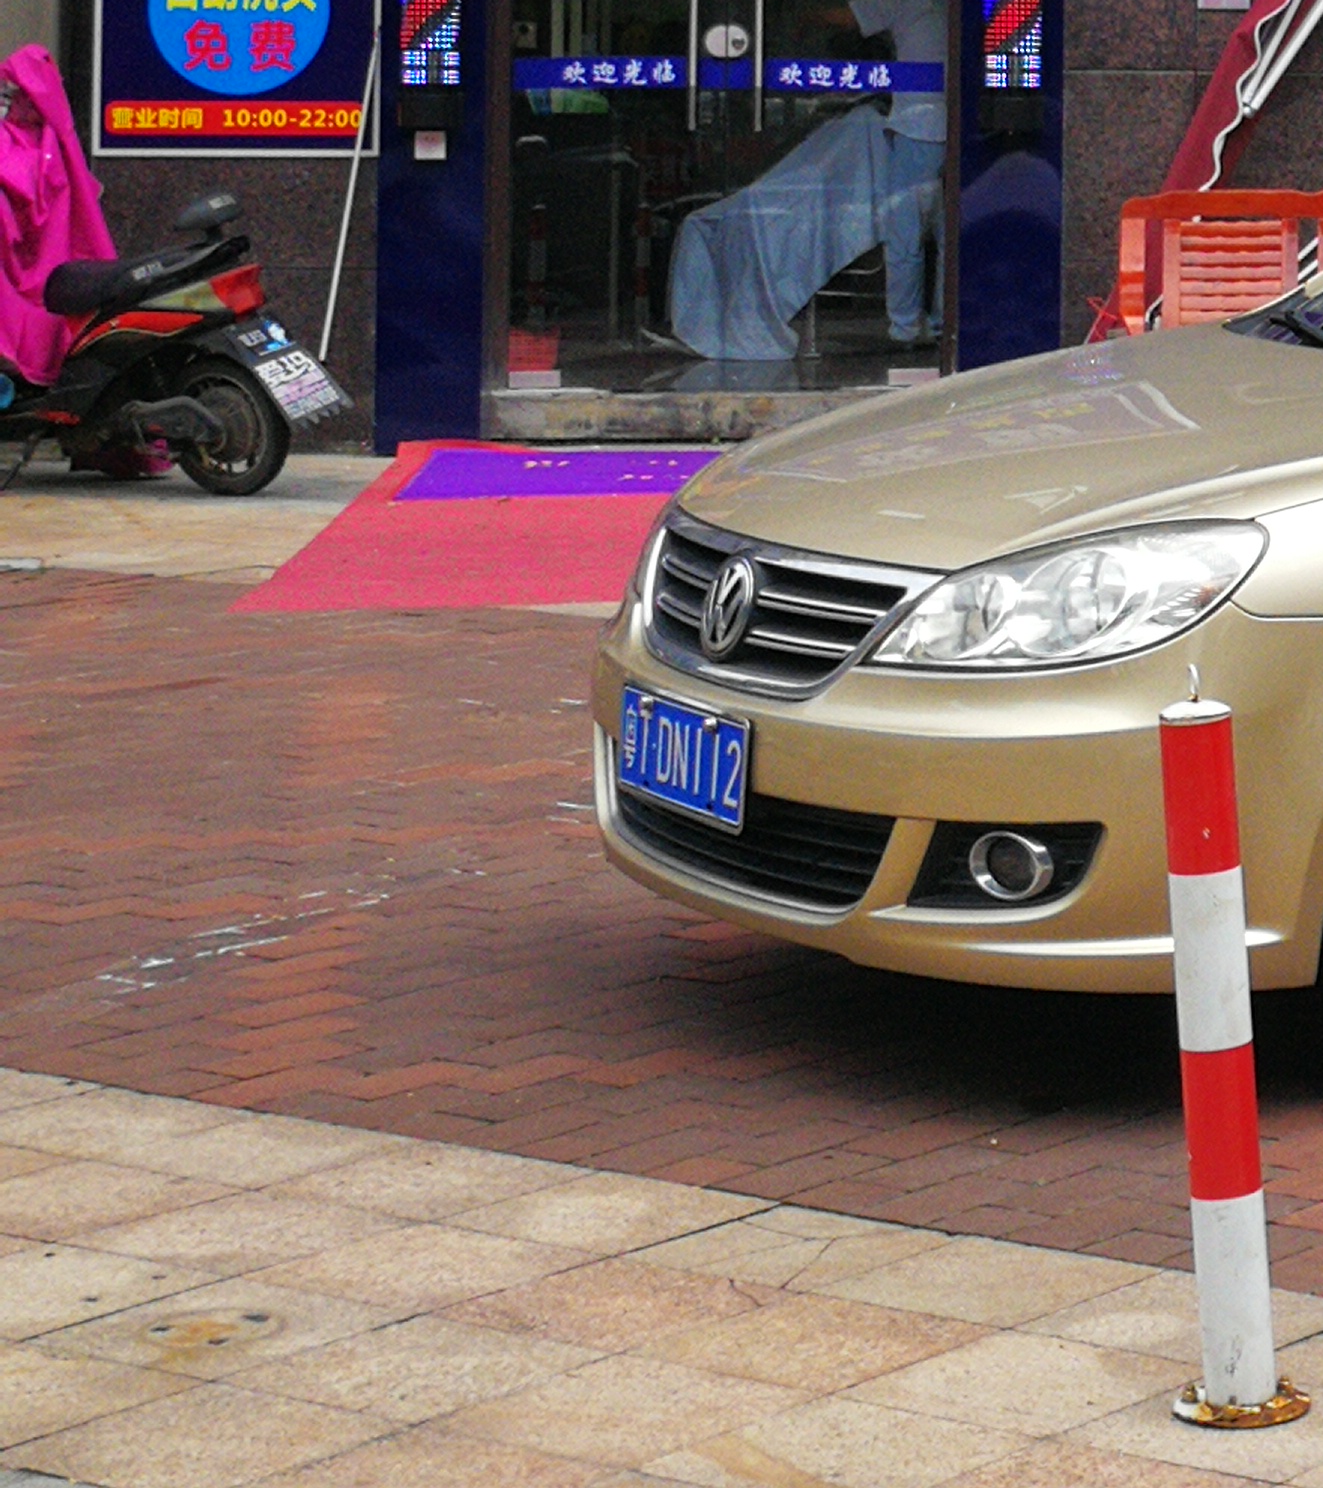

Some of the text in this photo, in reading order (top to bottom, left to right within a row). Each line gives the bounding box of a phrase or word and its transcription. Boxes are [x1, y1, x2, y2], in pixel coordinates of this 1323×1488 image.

[183, 19, 296, 73] 免费
[562, 60, 676, 86] 欢迎光临
[778, 63, 893, 90] 欢迎光临
[112, 107, 363, 130] 营业时间 10:00-22:00
